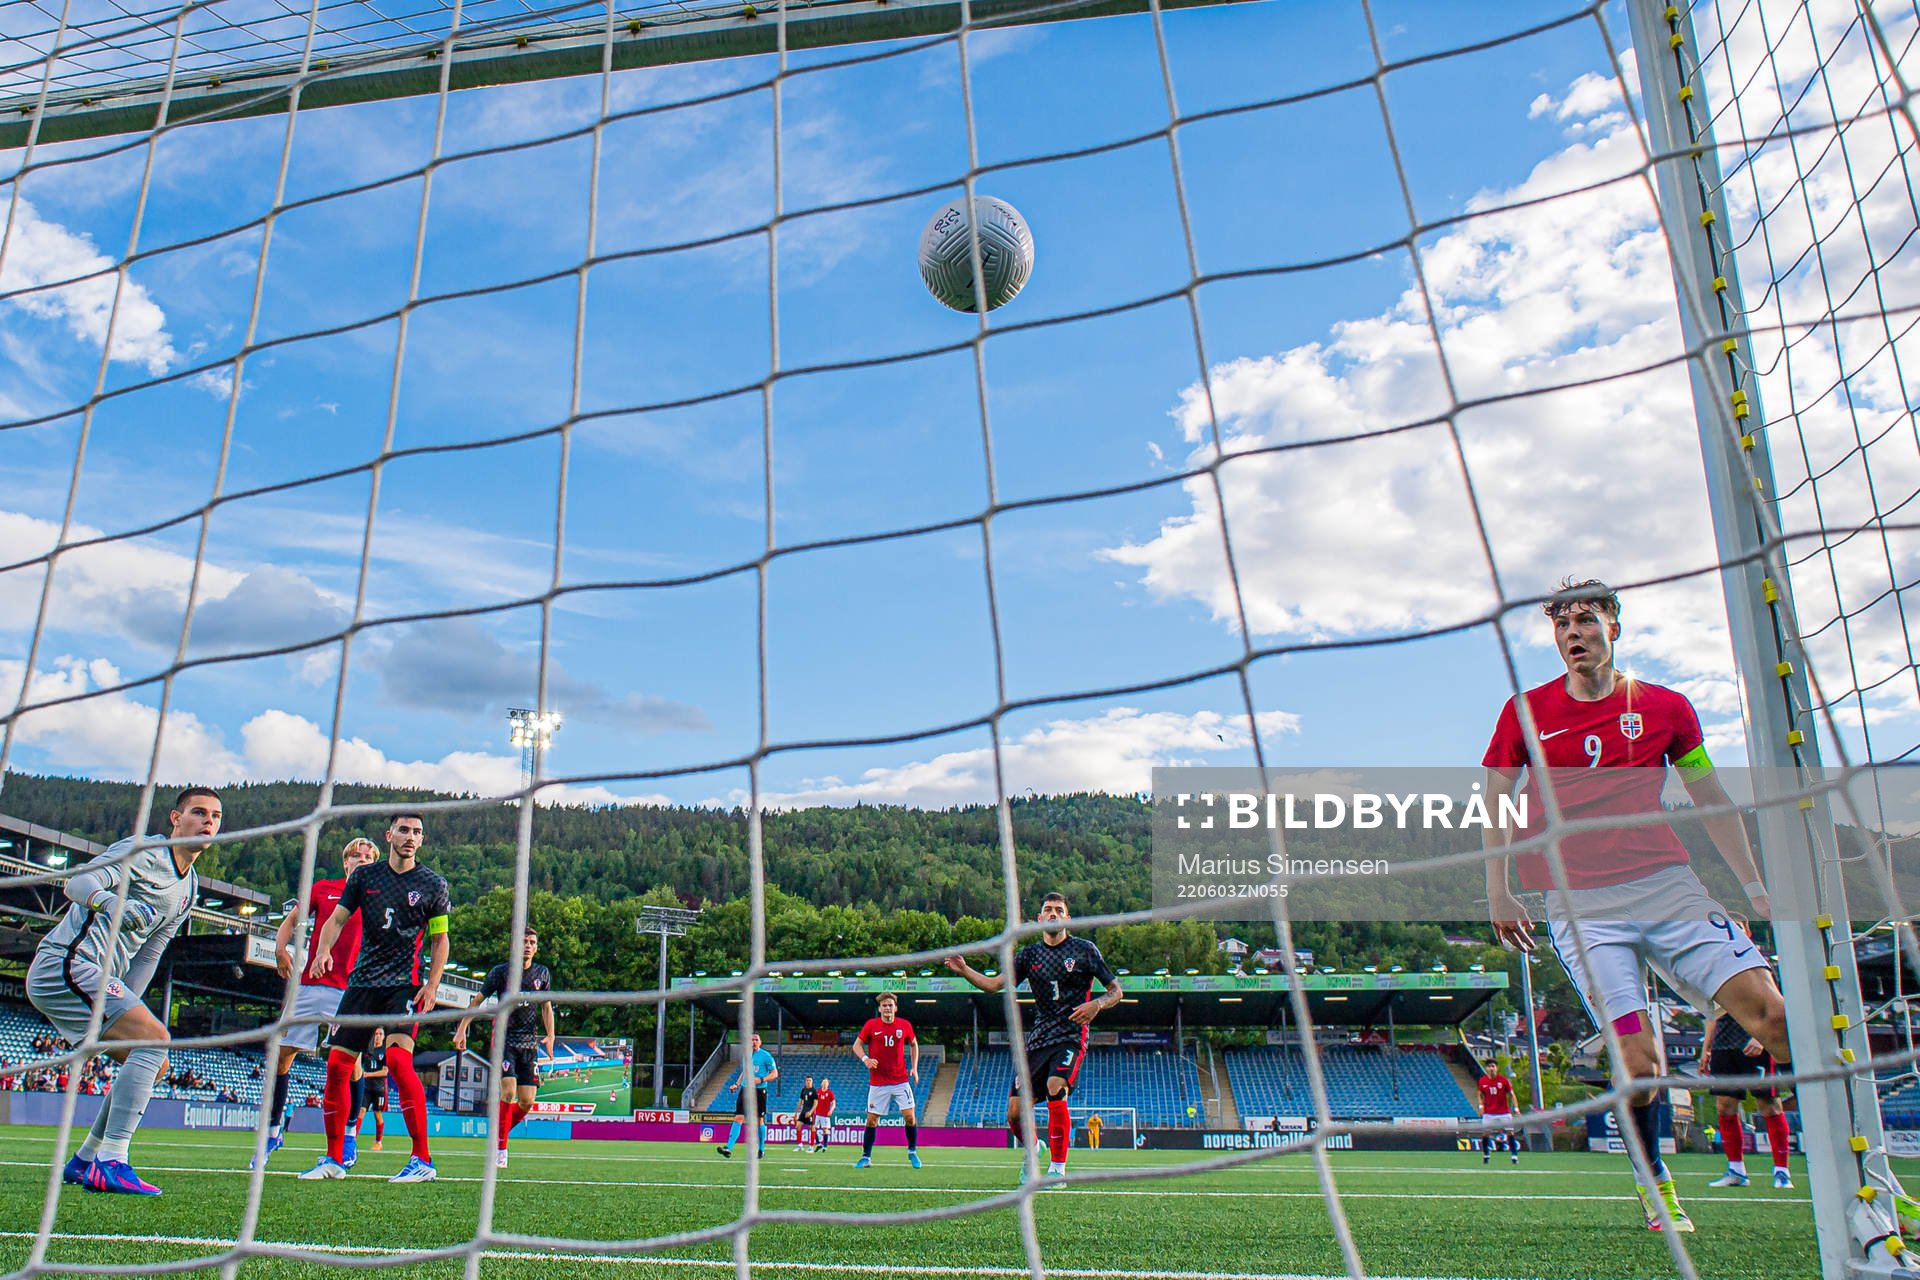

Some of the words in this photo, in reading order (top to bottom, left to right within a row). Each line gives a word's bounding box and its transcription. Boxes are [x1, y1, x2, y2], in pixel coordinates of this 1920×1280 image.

[1584, 735, 1602, 768] 9
[382, 907, 395, 929] 5
[1708, 911, 1735, 941] 9
[1050, 980, 1060, 1000] 3
[883, 1035, 895, 1047] 16
[1062, 1049, 1074, 1066] 3
[184, 1103, 221, 1129] Equinor
[222, 1105, 260, 1130] Landslag
[638, 1112, 657, 1122] RVS
[659, 1112, 671, 1122] AS
